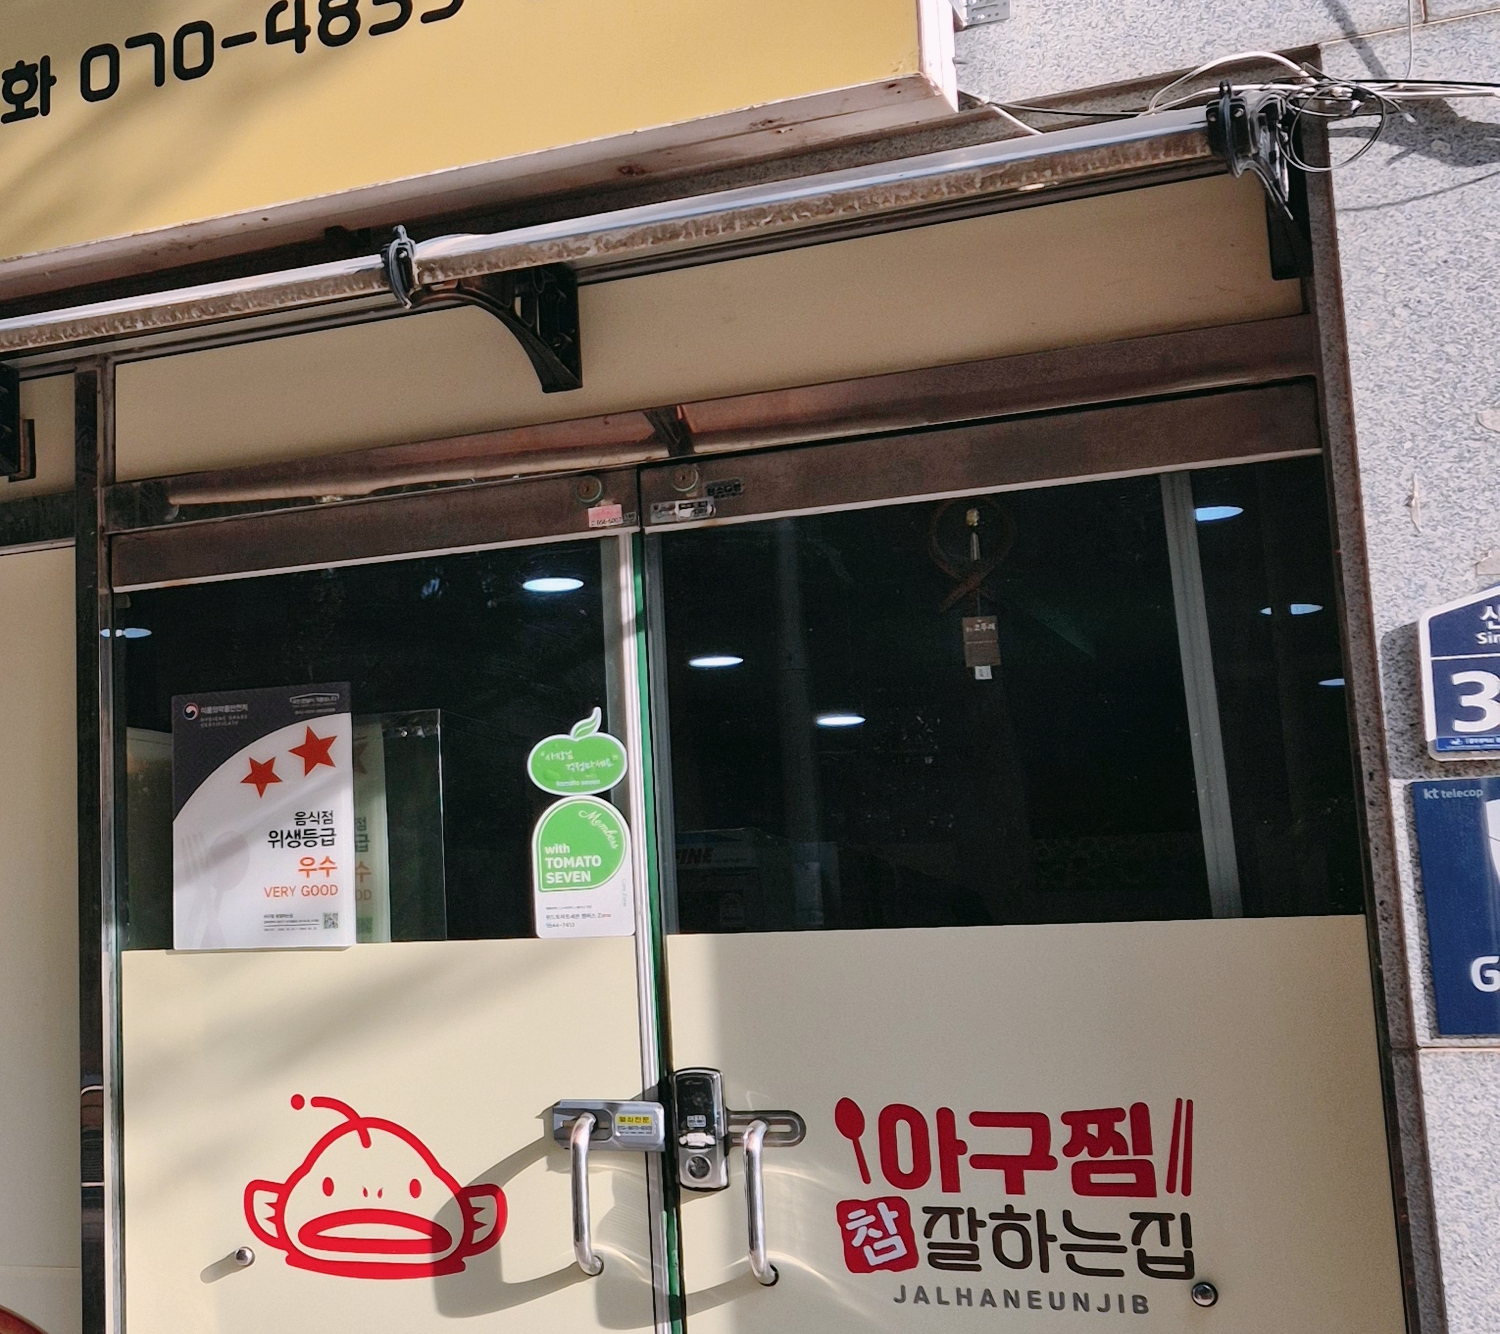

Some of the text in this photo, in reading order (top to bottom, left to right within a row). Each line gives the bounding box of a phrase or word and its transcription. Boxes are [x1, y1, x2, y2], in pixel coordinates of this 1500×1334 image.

[1423, 788, 1484, 800] kt telecop
[294, 810, 334, 826] 음식점
[267, 828, 337, 849] 위생등급
[579, 810, 619, 849] Members
[544, 843, 571, 855] with
[298, 855, 338, 878] 우수
[545, 855, 602, 869] TOMATO
[546, 870, 592, 884] SEVEN
[263, 884, 339, 898] VERY GOOD
[877, 1101, 1158, 1198] 아구찜
[921, 1203, 1196, 1281] 잘하는집
[892, 1283, 1150, 1315] JALHANEUNJIB
